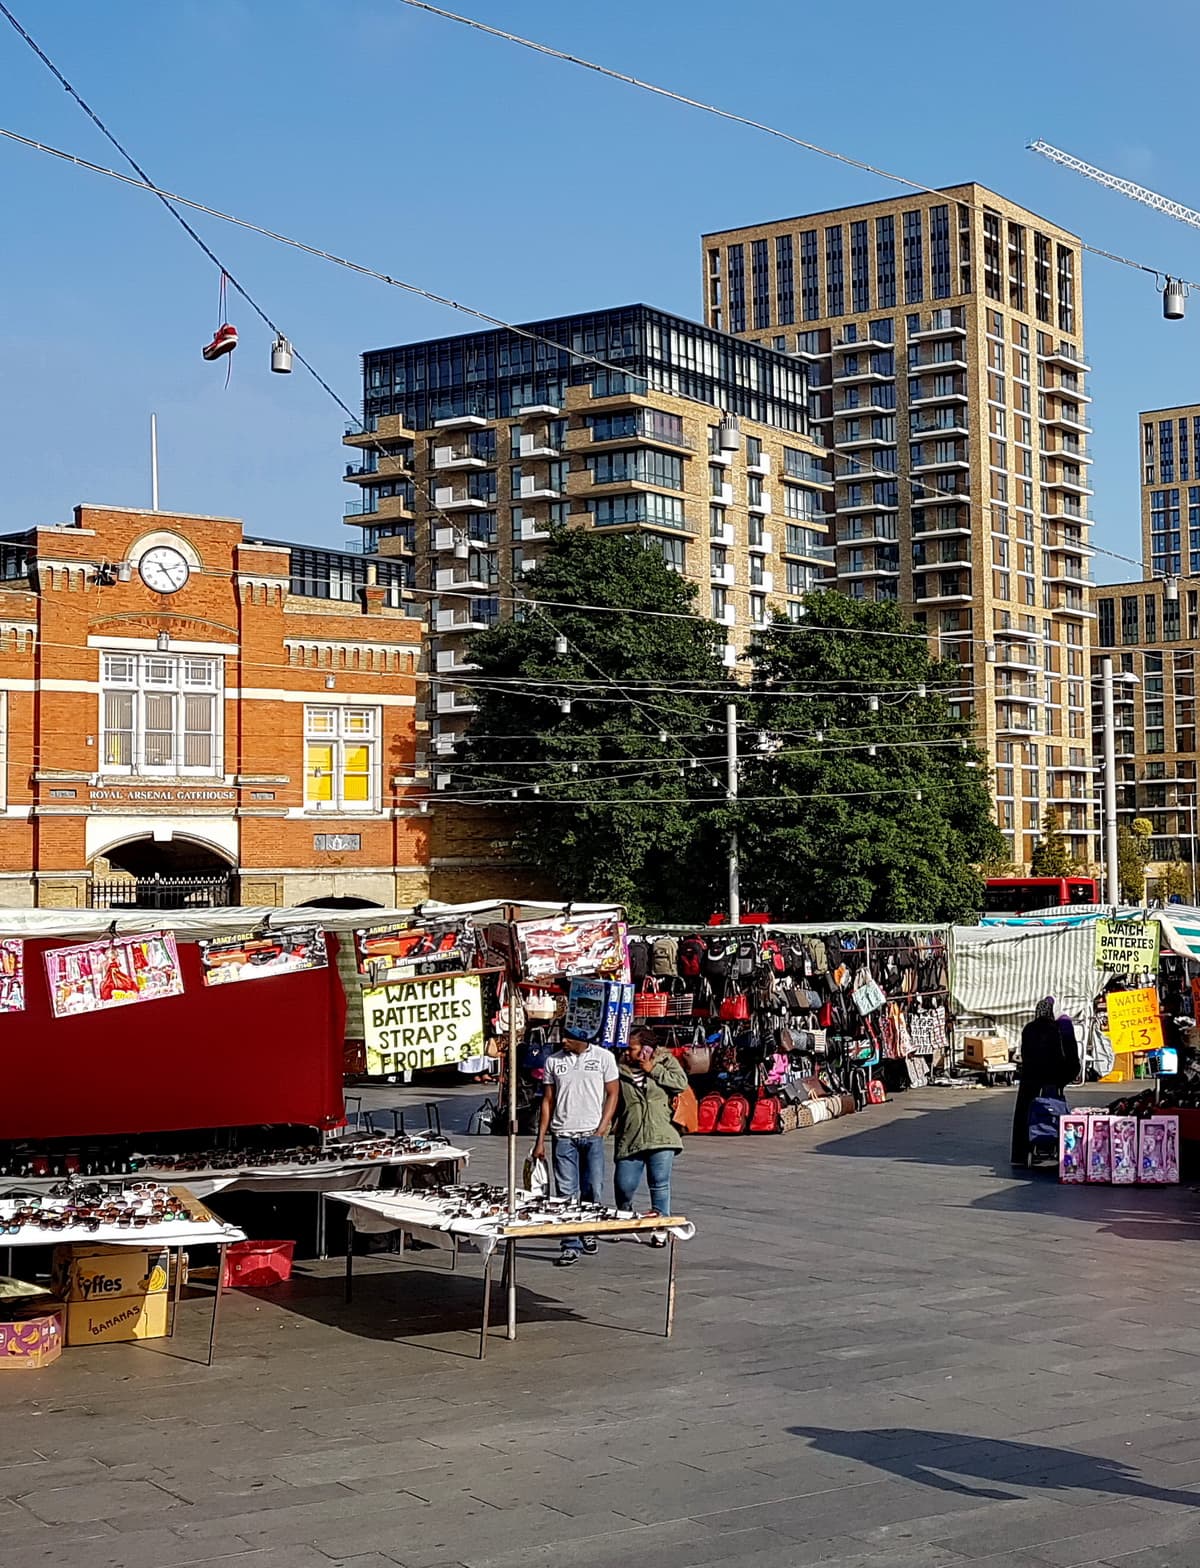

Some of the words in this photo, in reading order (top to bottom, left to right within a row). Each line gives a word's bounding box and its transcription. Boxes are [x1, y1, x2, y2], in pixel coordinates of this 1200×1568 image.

[89, 790, 123, 799] ROYAL
[127, 791, 174, 800] ARSENAL
[176, 791, 236, 800] GATEHOUSE
[1107, 923, 1144, 936] WATCH
[1101, 936, 1154, 949] BATTERIES
[1102, 949, 1140, 962] STRAPS
[1103, 962, 1130, 973] FROM
[384, 978, 455, 1004] WATCH
[1114, 991, 1150, 1007] WATCH
[372, 999, 471, 1028] BATTERIES
[1111, 1003, 1157, 1018] BATTERIES
[1119, 1016, 1153, 1029] STRAPS
[378, 1023, 457, 1050] STRAPS
[381, 1047, 435, 1074] FROM
